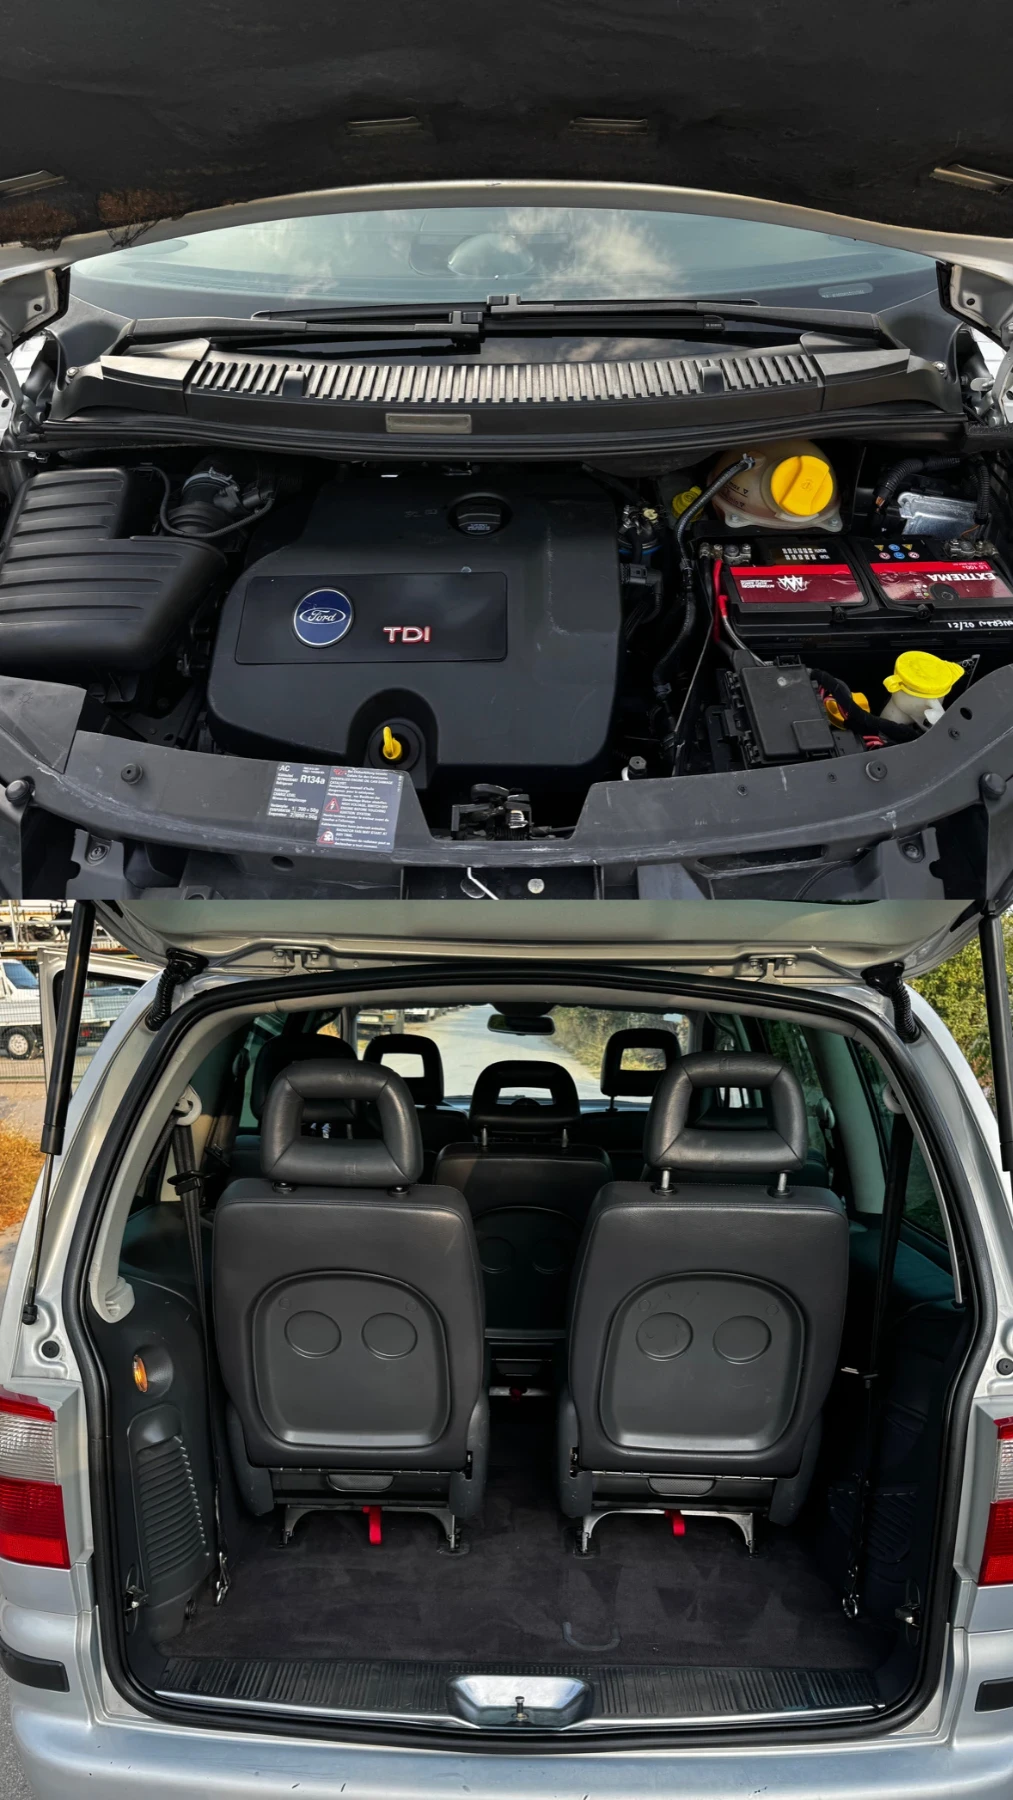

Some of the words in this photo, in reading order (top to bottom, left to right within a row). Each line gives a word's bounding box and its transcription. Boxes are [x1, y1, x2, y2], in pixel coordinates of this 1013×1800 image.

[926, 572, 997, 582] EXTREMA
[307, 609, 338, 622] Ford
[383, 625, 431, 643] TDI
[300, 774, 326, 785] R134a
